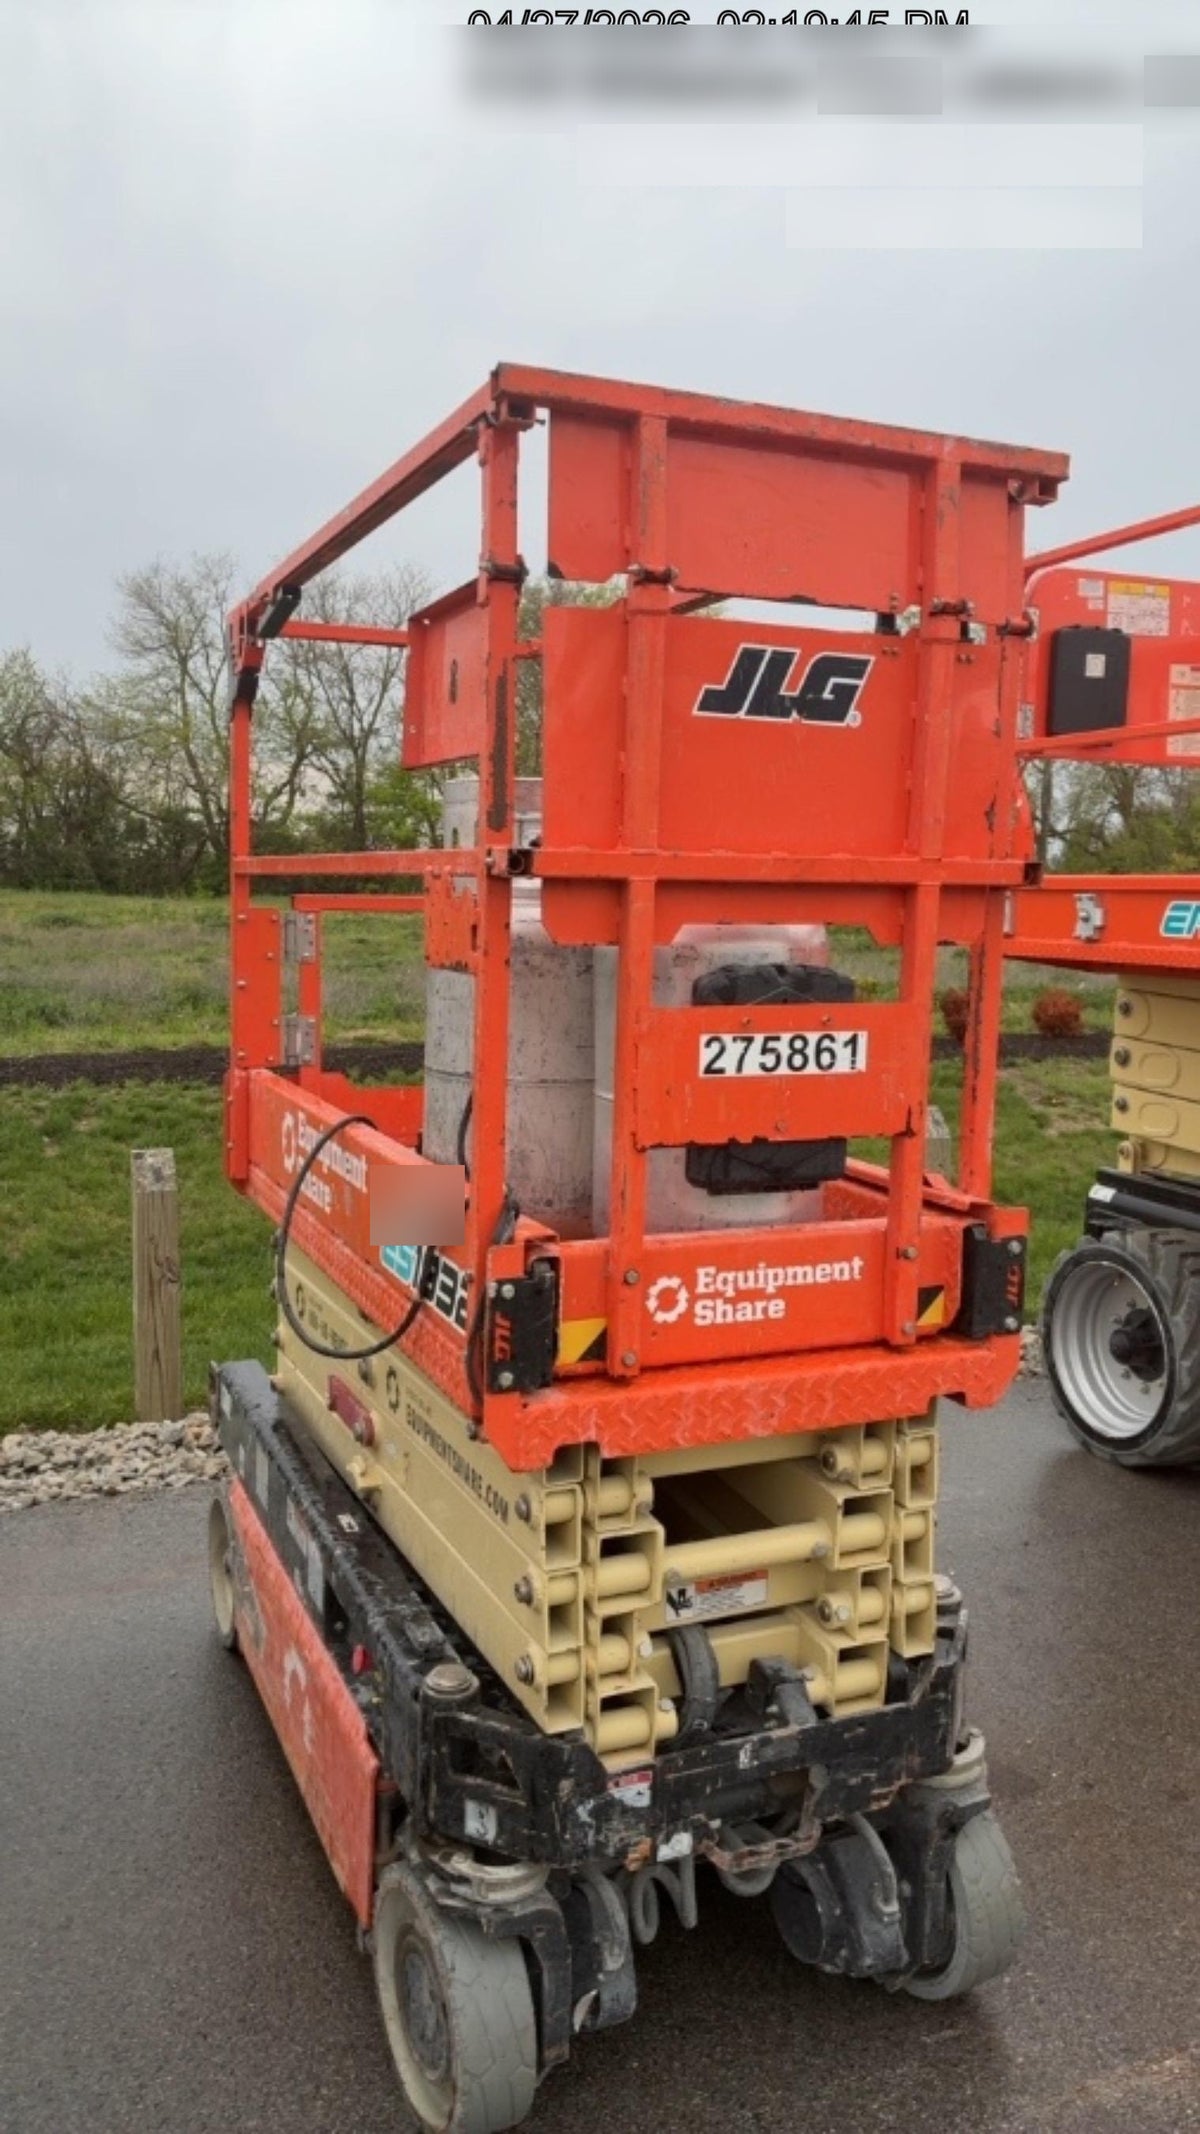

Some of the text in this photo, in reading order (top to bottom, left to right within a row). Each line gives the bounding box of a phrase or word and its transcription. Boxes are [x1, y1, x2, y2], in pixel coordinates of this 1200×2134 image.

[692, 642, 875, 727] JLG
[703, 1033, 859, 1075] 275861
[695, 1256, 864, 1297] Equipment
[694, 1297, 786, 1326] Share
